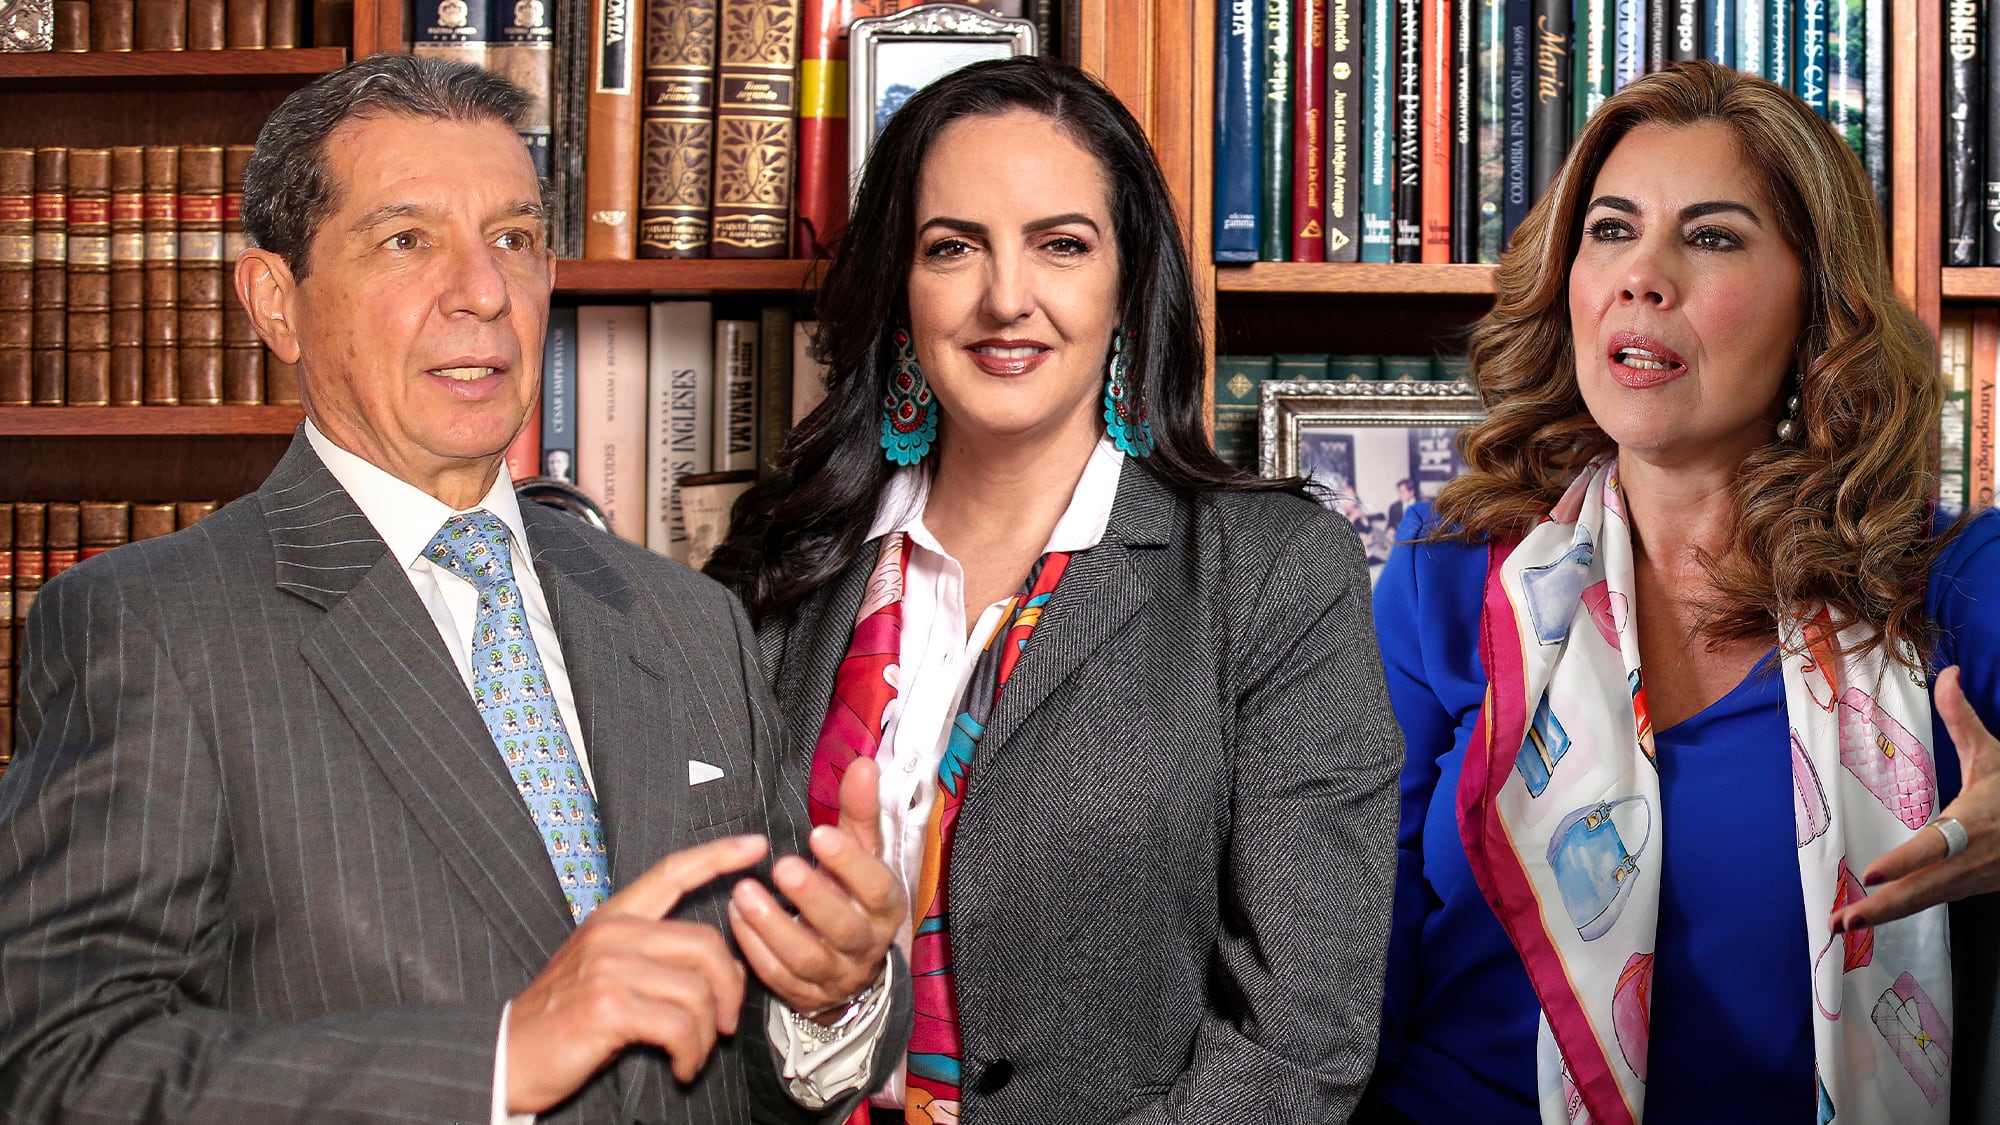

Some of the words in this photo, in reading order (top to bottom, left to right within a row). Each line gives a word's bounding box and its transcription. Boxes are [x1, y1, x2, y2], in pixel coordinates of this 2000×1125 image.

[1513, 25, 1525, 67] 1945-1995
[1804, 30, 1824, 57] ES
[1268, 60, 1288, 102] Atlas
[1511, 71, 1525, 99] ONU
[1334, 90, 1347, 118] Juan
[1510, 102, 1524, 116] LA
[1334, 119, 1347, 142] Luis
[1398, 94, 1419, 186] POPAYÁN
[1510, 119, 1524, 136] EN
[1373, 129, 1386, 186] Colombia
[1510, 139, 1524, 204] COLOMBIA
[1331, 176, 1346, 218] Arango
[554, 328, 565, 394] IMPERATOR
[607, 378, 616, 422] WILLIAM
[671, 369, 697, 452] INGLESES
[730, 381, 752, 455] PANAMA
[1976, 379, 1995, 482] Antropología
[604, 444, 616, 505] VIRTUDES
